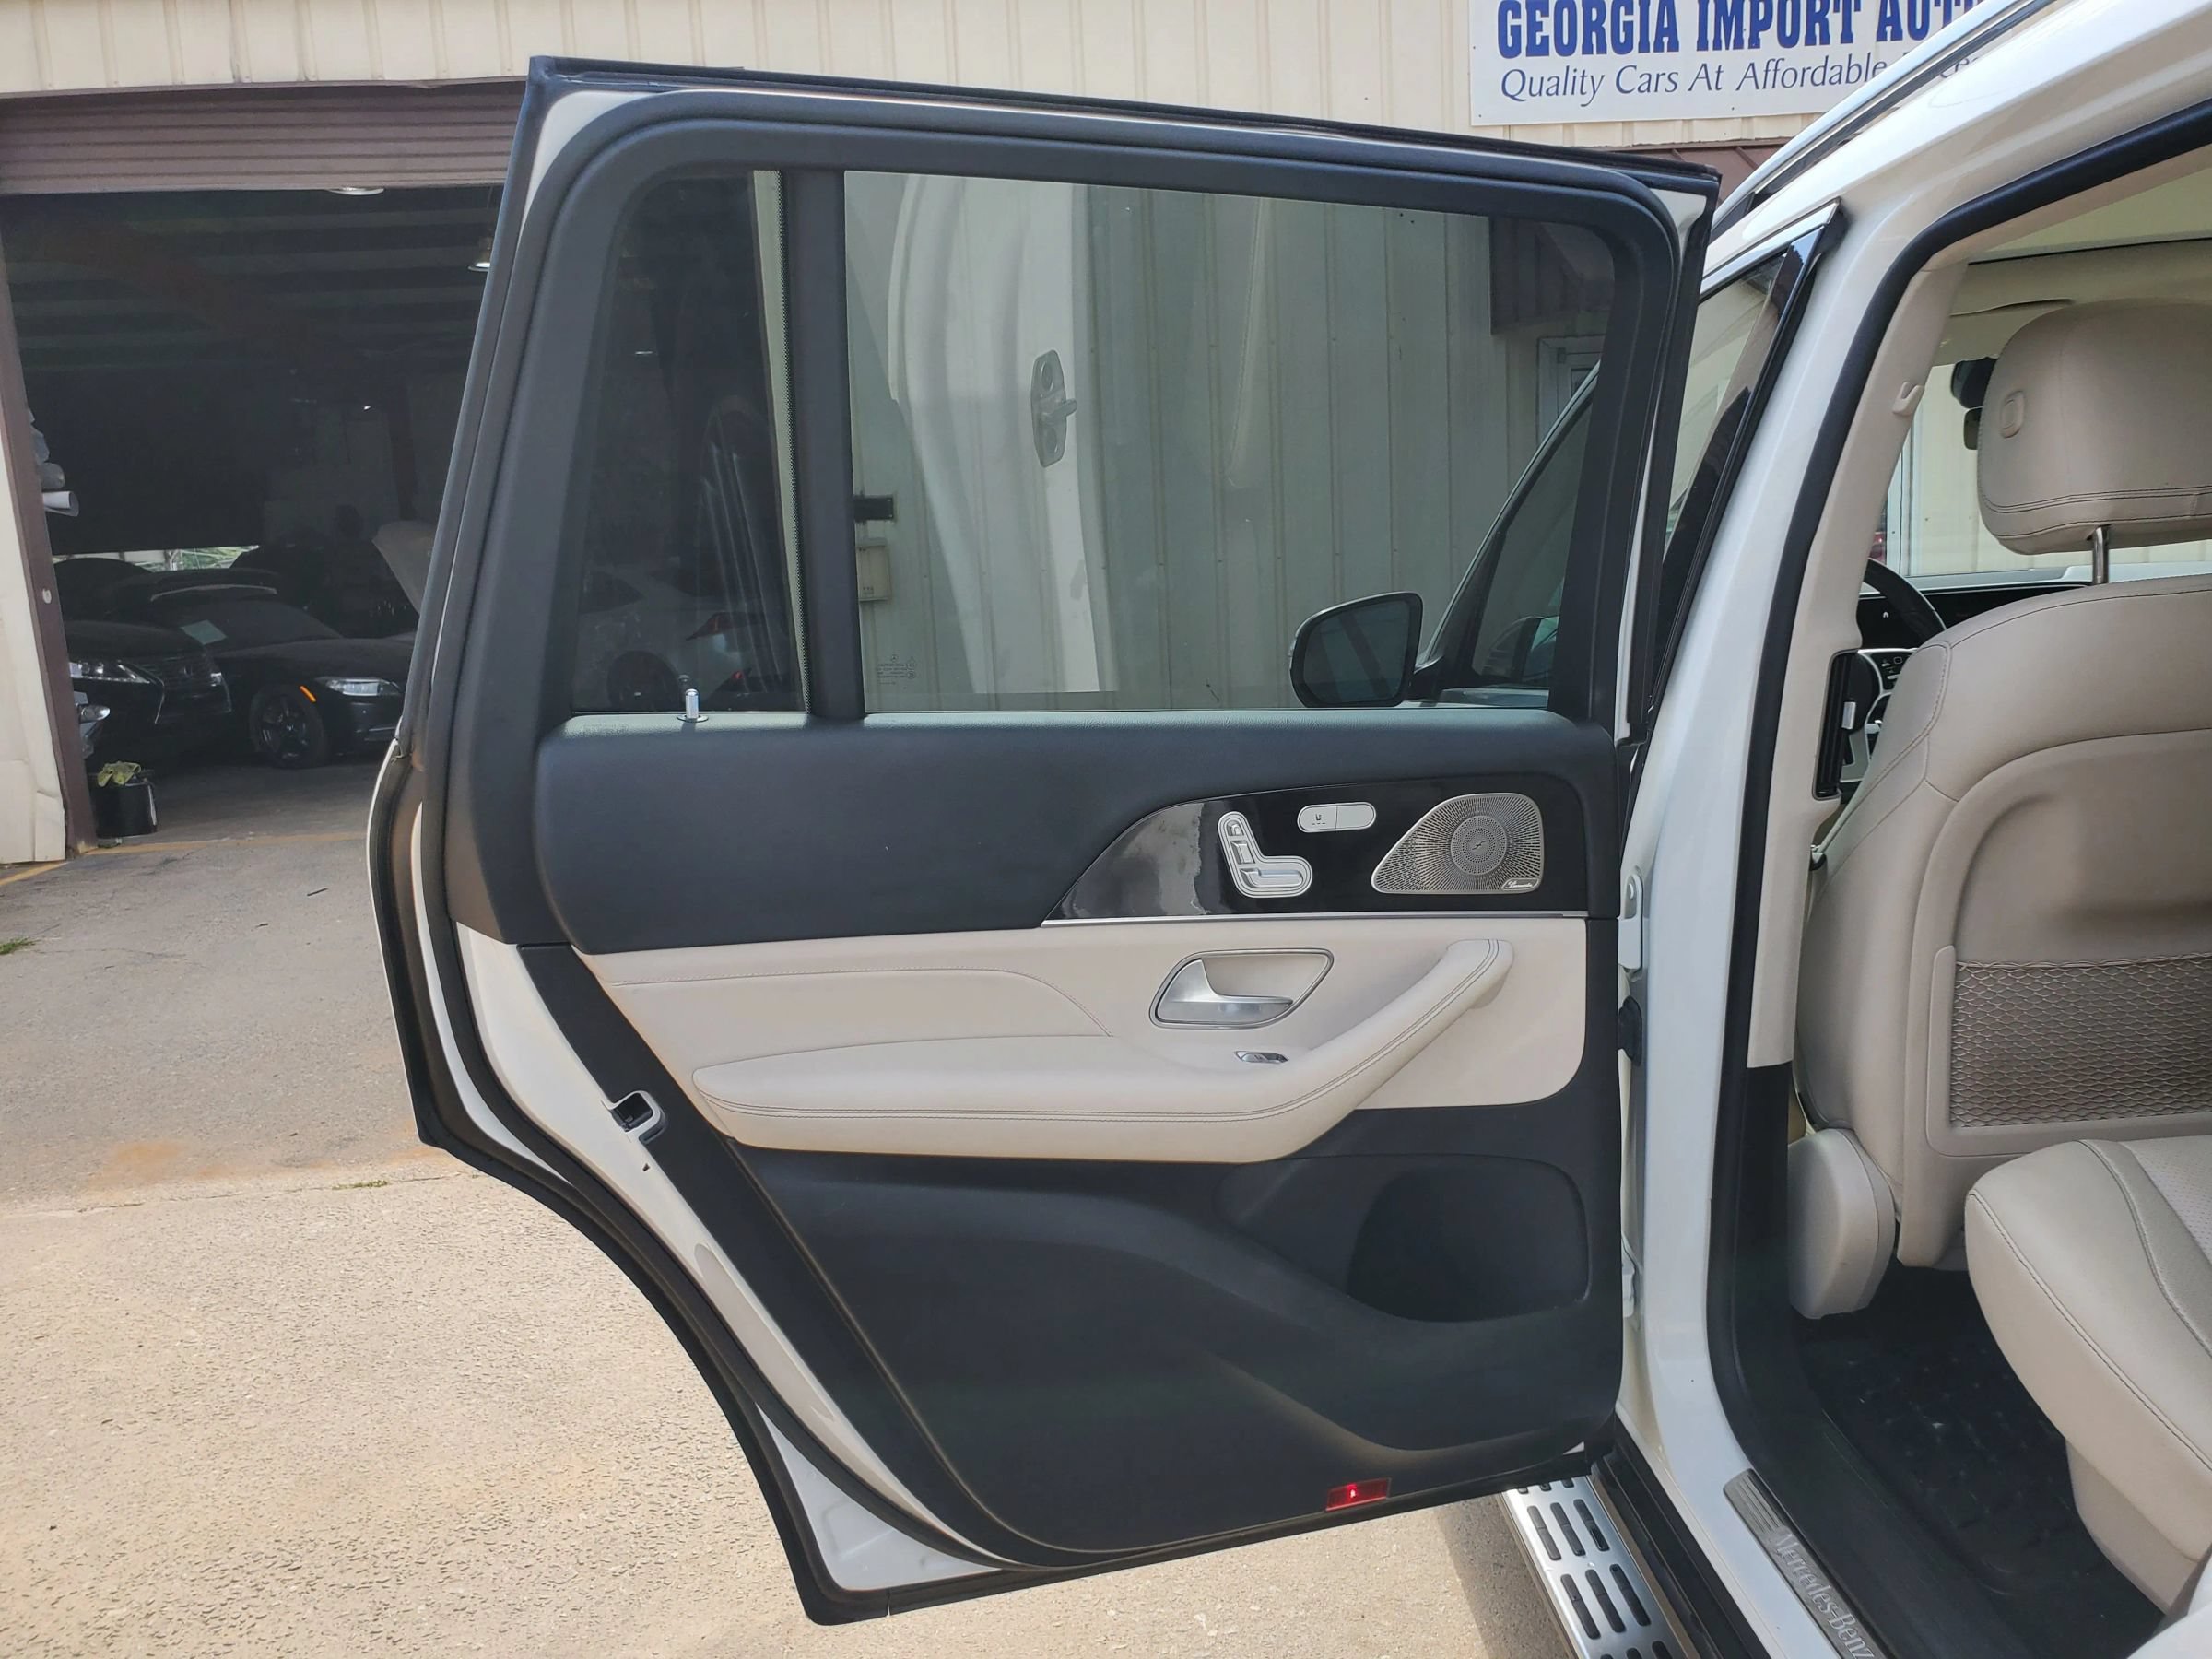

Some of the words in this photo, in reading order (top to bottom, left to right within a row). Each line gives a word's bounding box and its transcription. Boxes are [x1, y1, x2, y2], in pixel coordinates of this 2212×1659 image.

[1498, 0, 1679, 58] GEORGIA
[1697, 0, 1862, 51] IMPORT
[1876, 0, 1983, 42] AUT
[1501, 65, 1606, 107] Quality
[1615, 65, 1679, 94] Cars
[1688, 63, 1724, 92] At
[1735, 52, 1888, 91] Affordable
[1775, 1533, 1875, 1659] Mercedes-Benz
